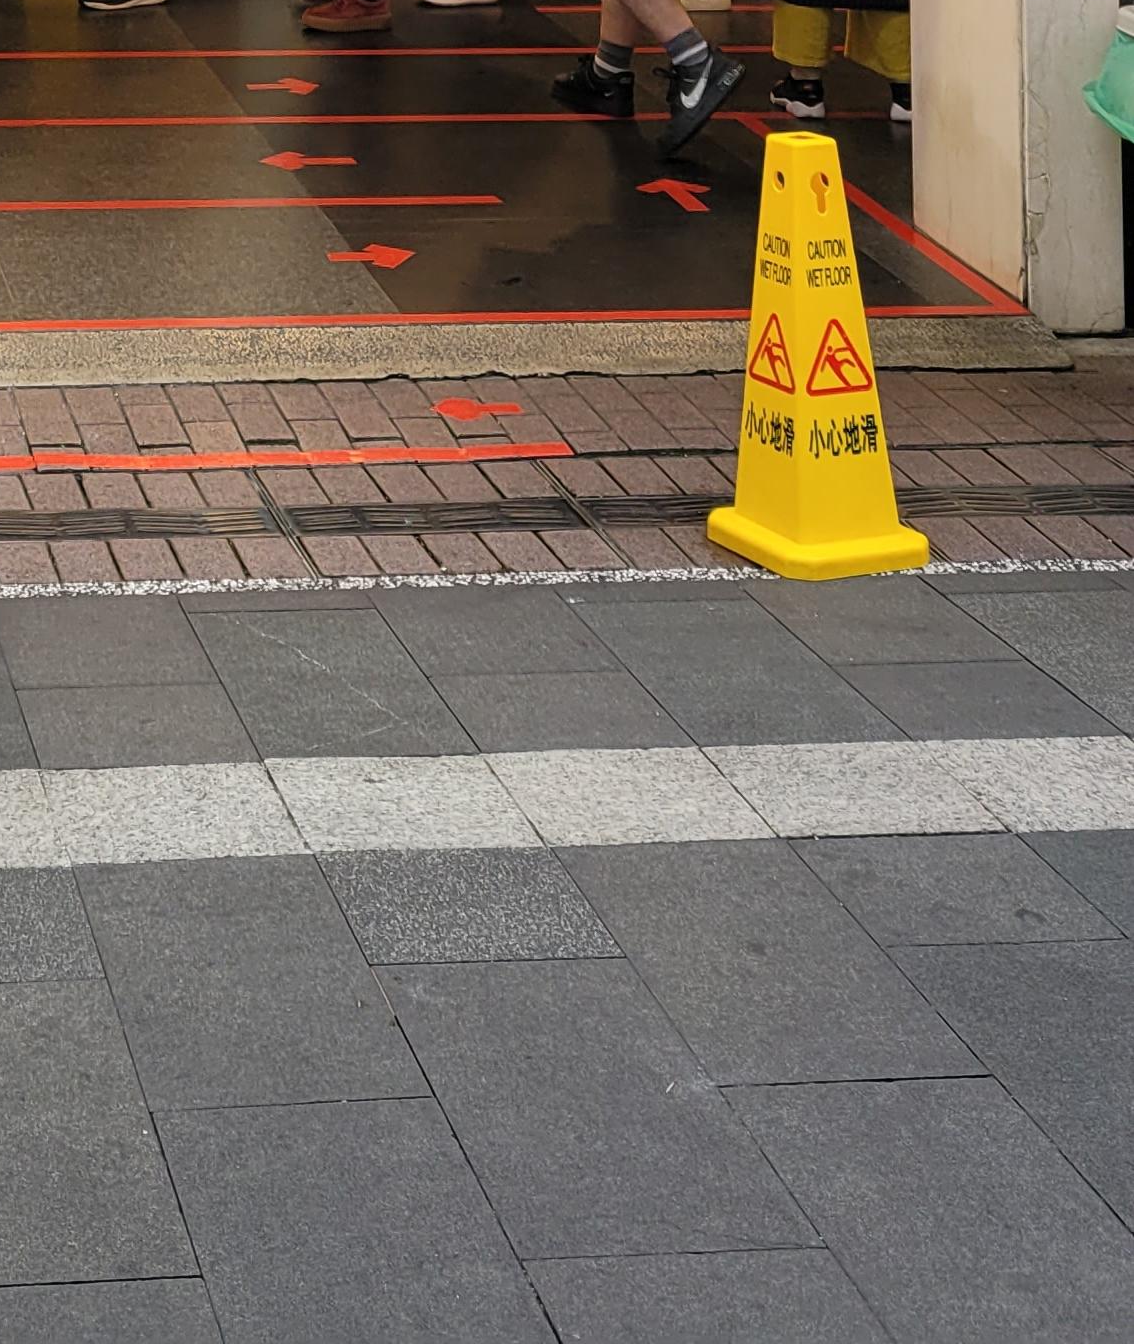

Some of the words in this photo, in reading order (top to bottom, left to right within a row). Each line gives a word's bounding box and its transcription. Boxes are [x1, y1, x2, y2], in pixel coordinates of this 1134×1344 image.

[762, 232, 791, 260] CAUTION
[807, 238, 847, 261] CAUTION
[745, 400, 796, 458] 小心地滑
[808, 413, 879, 460] 小心地滑
